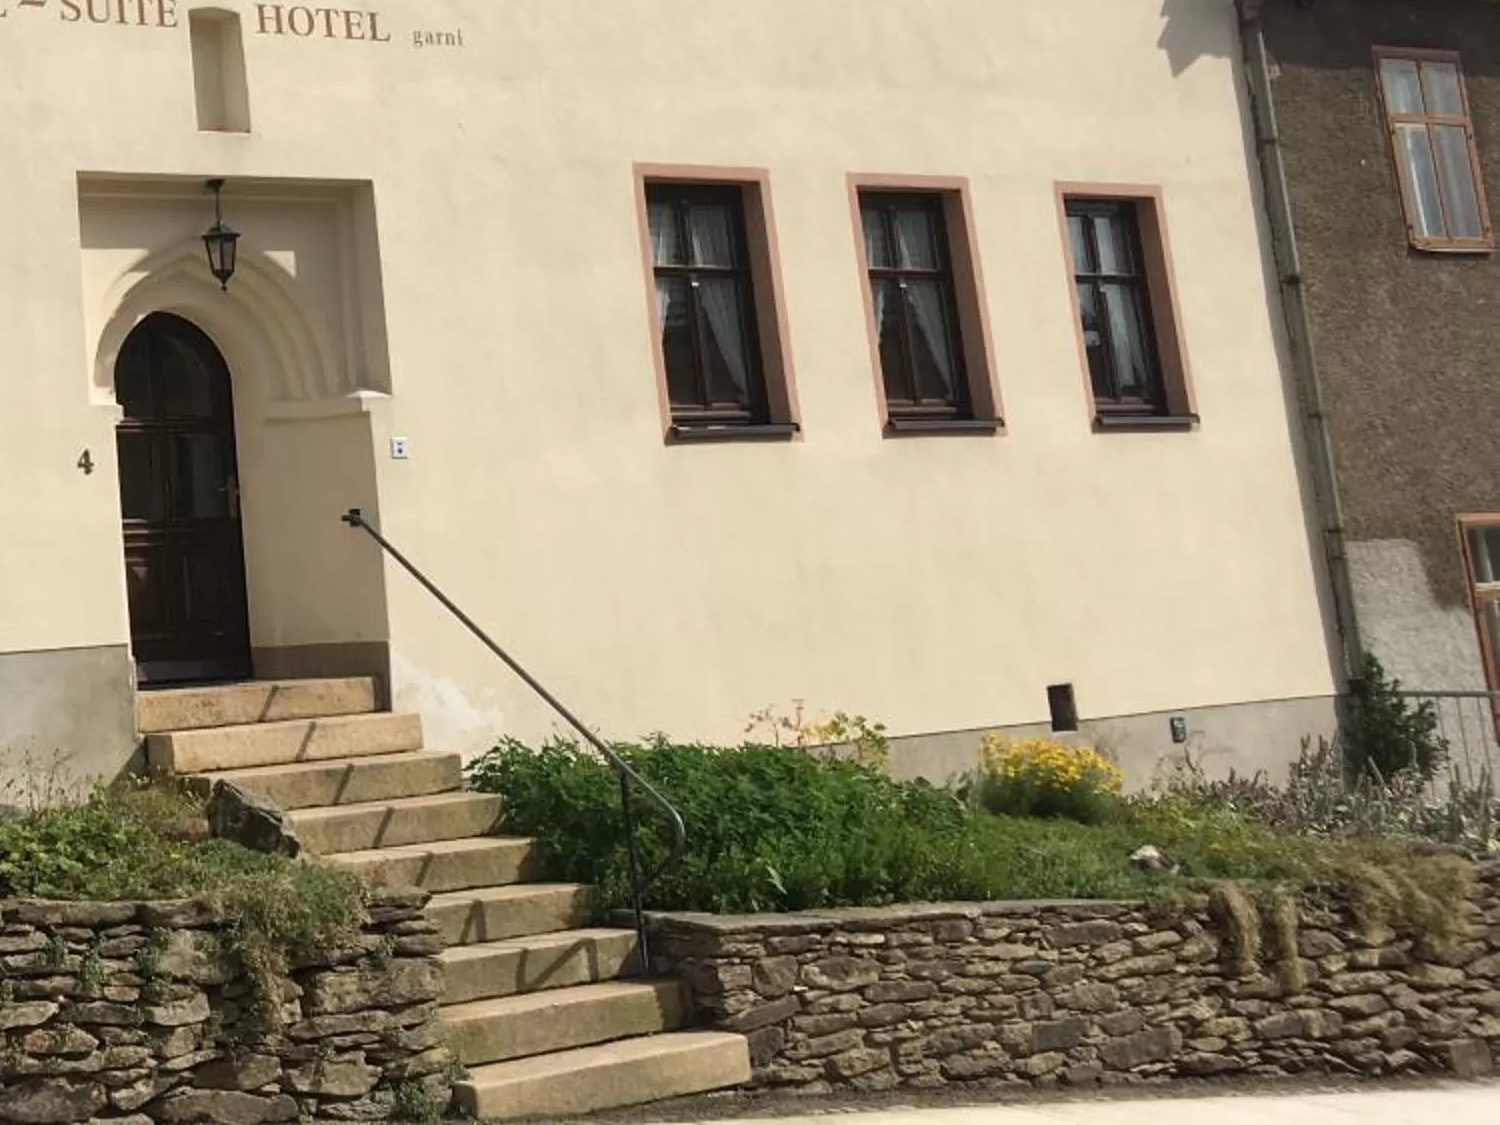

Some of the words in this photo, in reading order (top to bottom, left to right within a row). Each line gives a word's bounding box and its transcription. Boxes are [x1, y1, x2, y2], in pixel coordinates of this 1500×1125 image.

[255, 2, 392, 43] HOTEL
[412, 26, 465, 50] garni
[77, 448, 95, 475] 4
